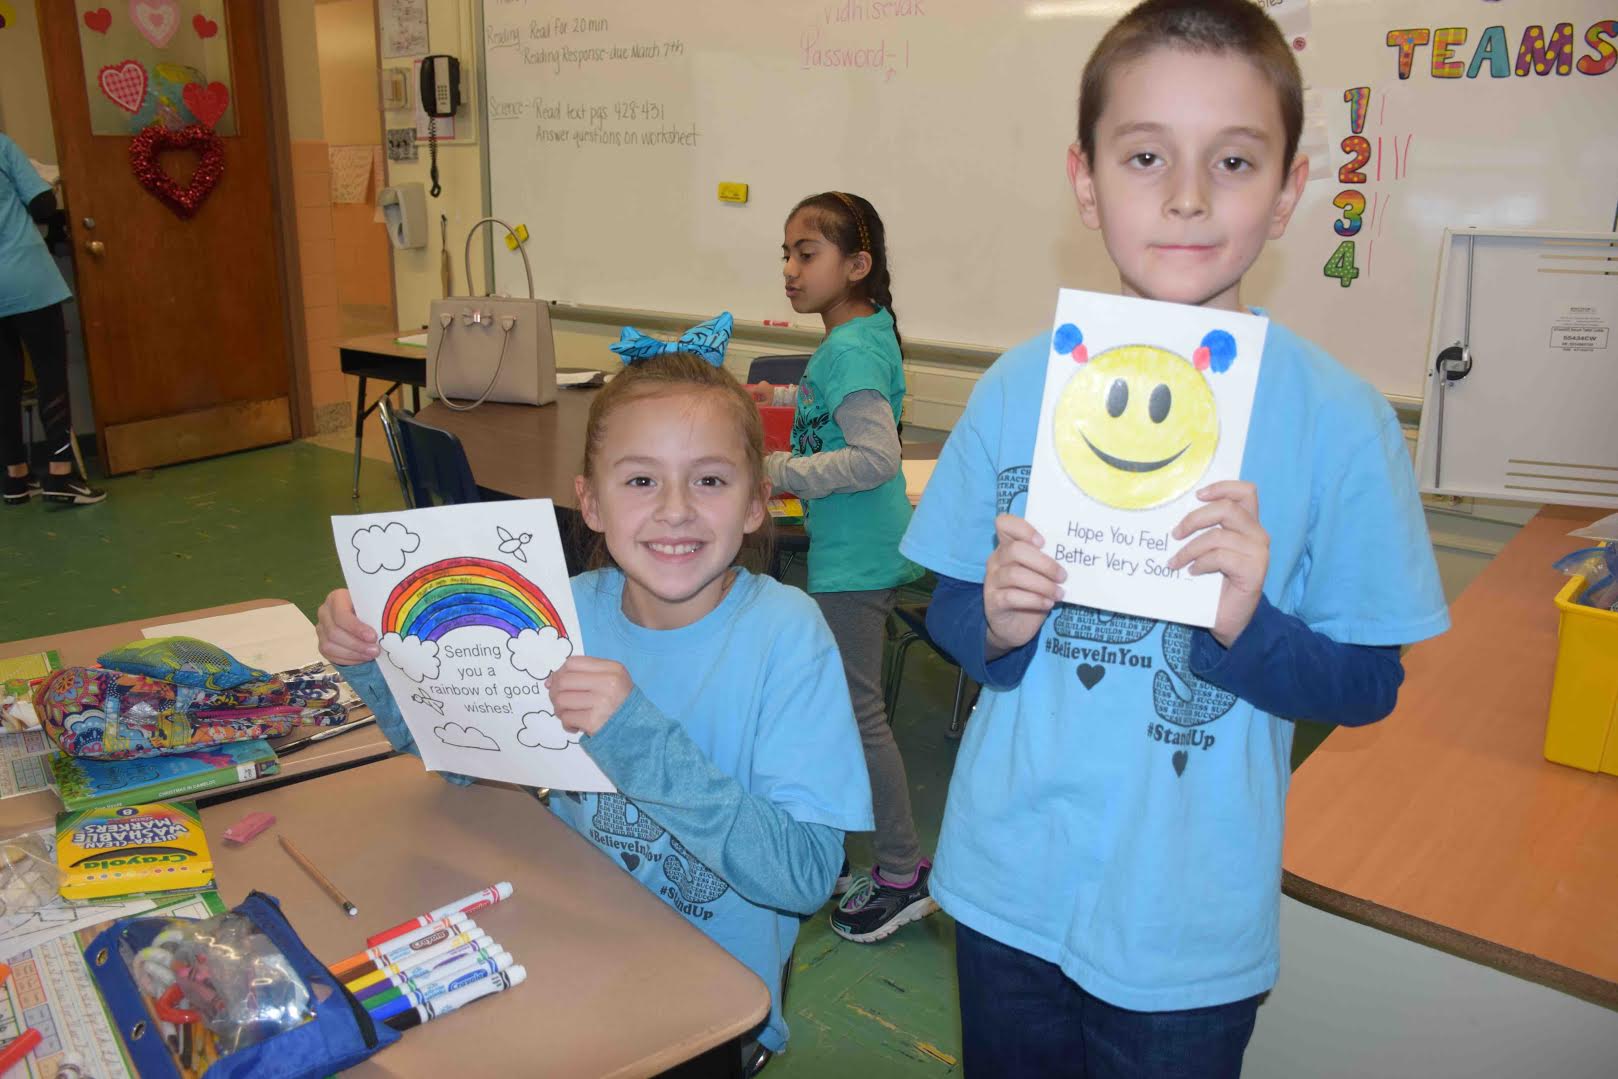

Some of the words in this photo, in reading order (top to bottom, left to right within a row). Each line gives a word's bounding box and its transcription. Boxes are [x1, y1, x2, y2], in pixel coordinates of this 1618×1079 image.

[529, 20, 551, 40] Read
[554, 17, 567, 36] for
[572, 18, 586, 33] 20
[588, 18, 608, 33] min
[523, 49, 560, 75] Reading
[631, 43, 660, 59] March
[662, 40, 684, 57] 7th
[1386, 20, 1618, 80] TEAMS
[535, 99, 561, 120] Read
[567, 103, 586, 120] text
[614, 100, 665, 120] 428-431
[1344, 86, 1371, 134] 1
[536, 126, 569, 142] Answer
[572, 128, 621, 148] questions
[624, 131, 637, 145] on
[641, 124, 700, 147] worksheet
[1338, 135, 1371, 183] 2
[1333, 189, 1366, 237] 3
[1323, 240, 1359, 287] 4
[1067, 520, 1104, 544] Hope
[1110, 526, 1135, 546] You
[1139, 530, 1168, 552] Feel
[1055, 544, 1101, 566] Better
[1105, 552, 1140, 577] Very
[1144, 558, 1180, 580] Soon
[444, 644, 502, 659] Sending
[1045, 638, 1152, 669] #BelieveInYou
[457, 667, 483, 680] you
[487, 667, 496, 677] a
[430, 683, 480, 696] rainbow
[485, 683, 498, 695] of
[503, 682, 540, 698] good
[464, 702, 514, 714] wishes!
[1146, 722, 1216, 750] #StandUp
[159, 786, 186, 798] CHRISTMAS
[122, 808, 133, 816] 8
[73, 822, 190, 844] WASHABLE
[83, 817, 172, 833] MARKERS
[84, 833, 178, 849] ULTRA-CLEAN
[83, 853, 188, 870] Crayola
[411, 931, 447, 950] Crayola
